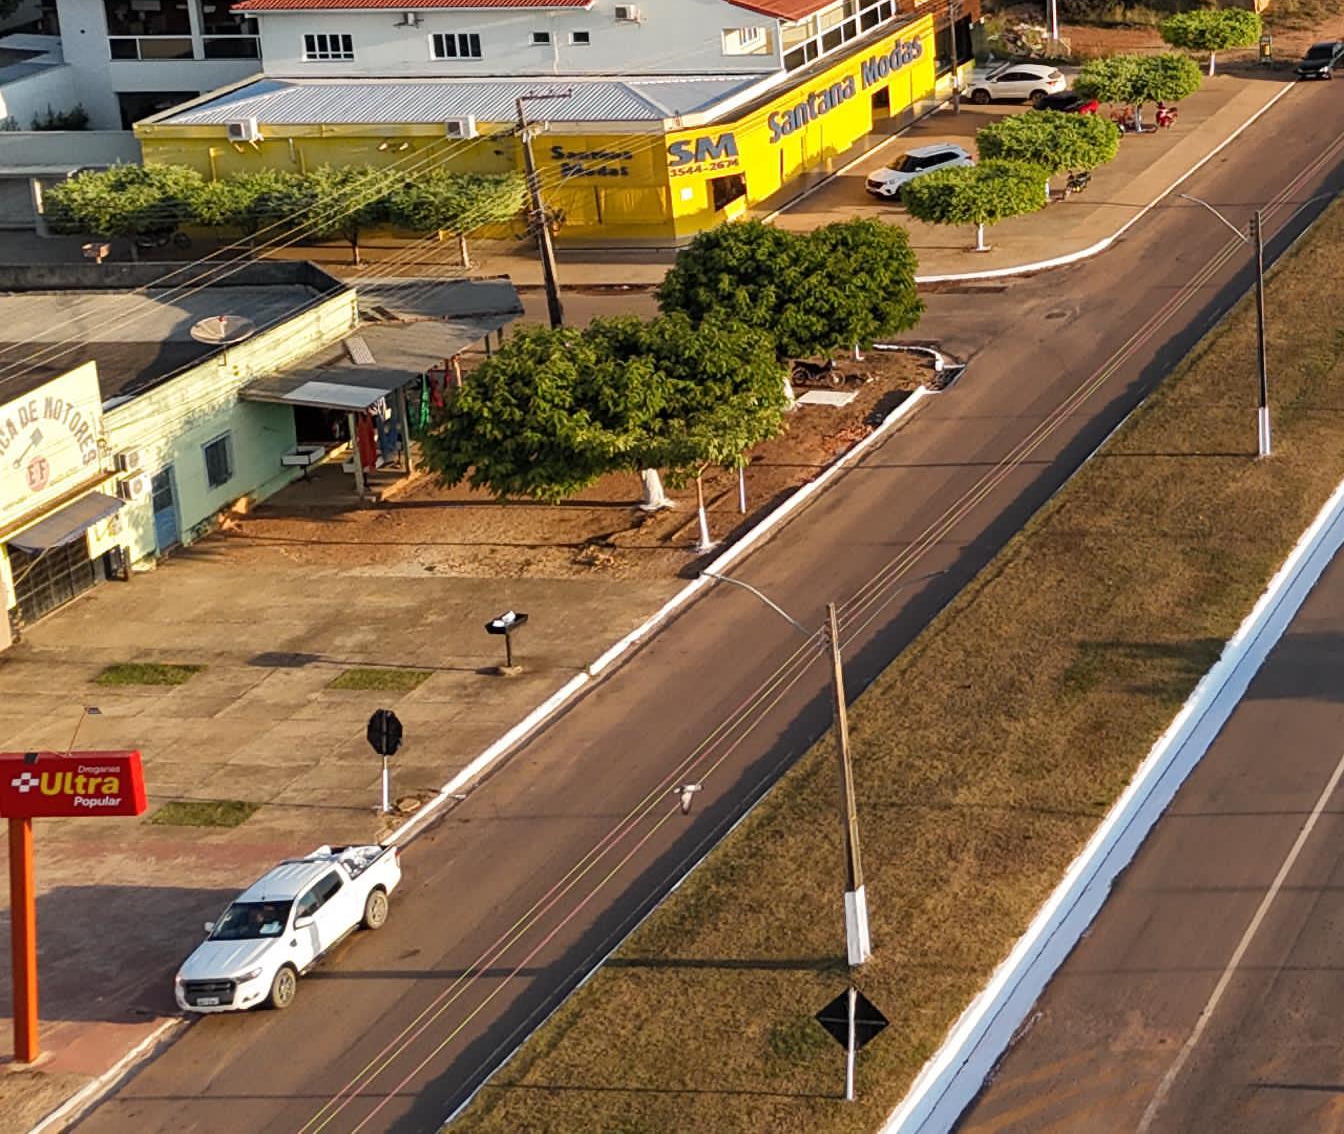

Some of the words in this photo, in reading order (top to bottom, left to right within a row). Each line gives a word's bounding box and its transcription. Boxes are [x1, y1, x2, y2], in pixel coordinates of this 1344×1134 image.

[768, 74, 857, 144] Santana
[860, 34, 922, 91] Modas
[668, 132, 739, 166] SM
[560, 162, 629, 177] Modas
[18, 399, 38, 429] DE
[43, 396, 97, 466] MOTORES
[40, 772, 120, 796] Ultra
[73, 796, 122, 809] Popular
